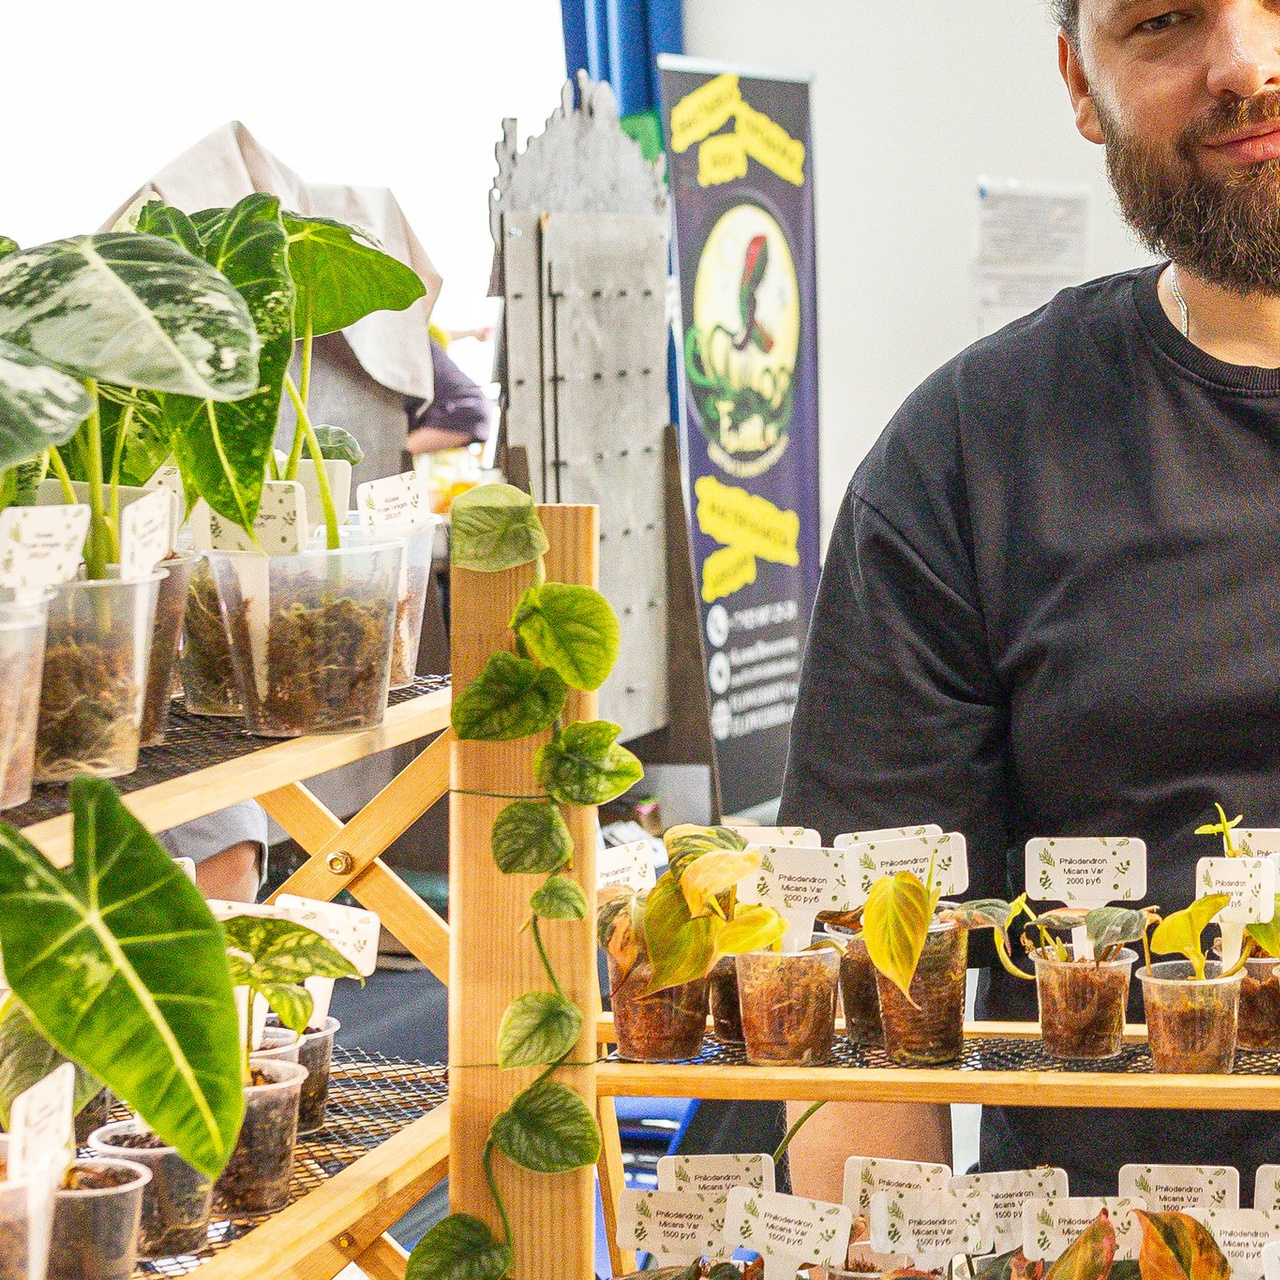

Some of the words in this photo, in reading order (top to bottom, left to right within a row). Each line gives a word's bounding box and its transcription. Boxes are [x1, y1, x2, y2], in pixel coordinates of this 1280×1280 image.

[881, 858, 929, 868] Philodendron
[779, 874, 827, 884] Philodendron
[879, 1179, 921, 1189] Philodendron
[656, 1211, 703, 1220] Philodendron
[764, 1212, 812, 1228] Philodendron
[766, 1222, 792, 1233] Micans
[1220, 1230, 1269, 1238] Philodendron
